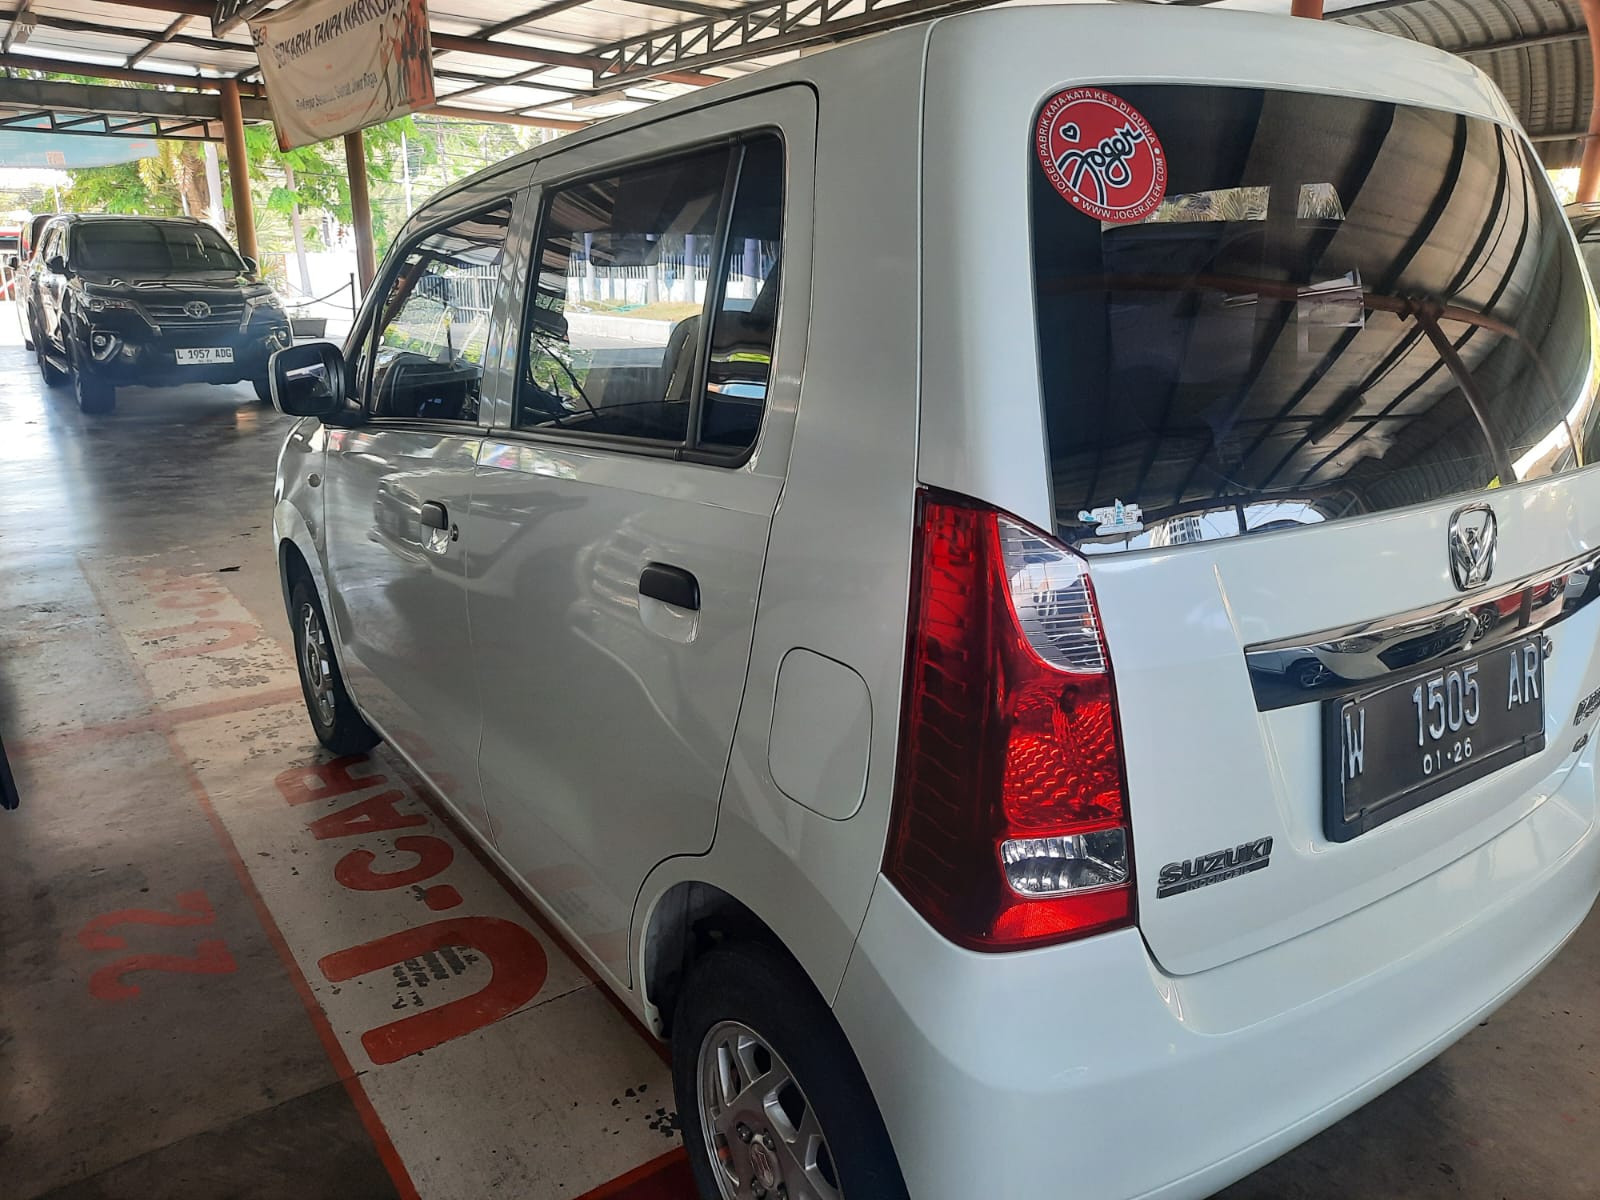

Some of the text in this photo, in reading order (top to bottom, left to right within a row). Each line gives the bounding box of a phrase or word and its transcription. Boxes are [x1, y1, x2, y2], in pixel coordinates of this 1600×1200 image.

[314, 11, 344, 47] TANPA
[1119, 102, 1131, 114] DI
[1038, 118, 1050, 157] PABRIK
[1130, 111, 1156, 145] DUNIA
[1044, 160, 1071, 194] JOGER
[176, 348, 232, 359] L 1957 ADG
[1345, 706, 1365, 779] W
[1412, 663, 1481, 747] 1505
[1507, 641, 1540, 711] AR
[1158, 835, 1274, 884] SUZUKI
[78, 888, 239, 1002] 22
